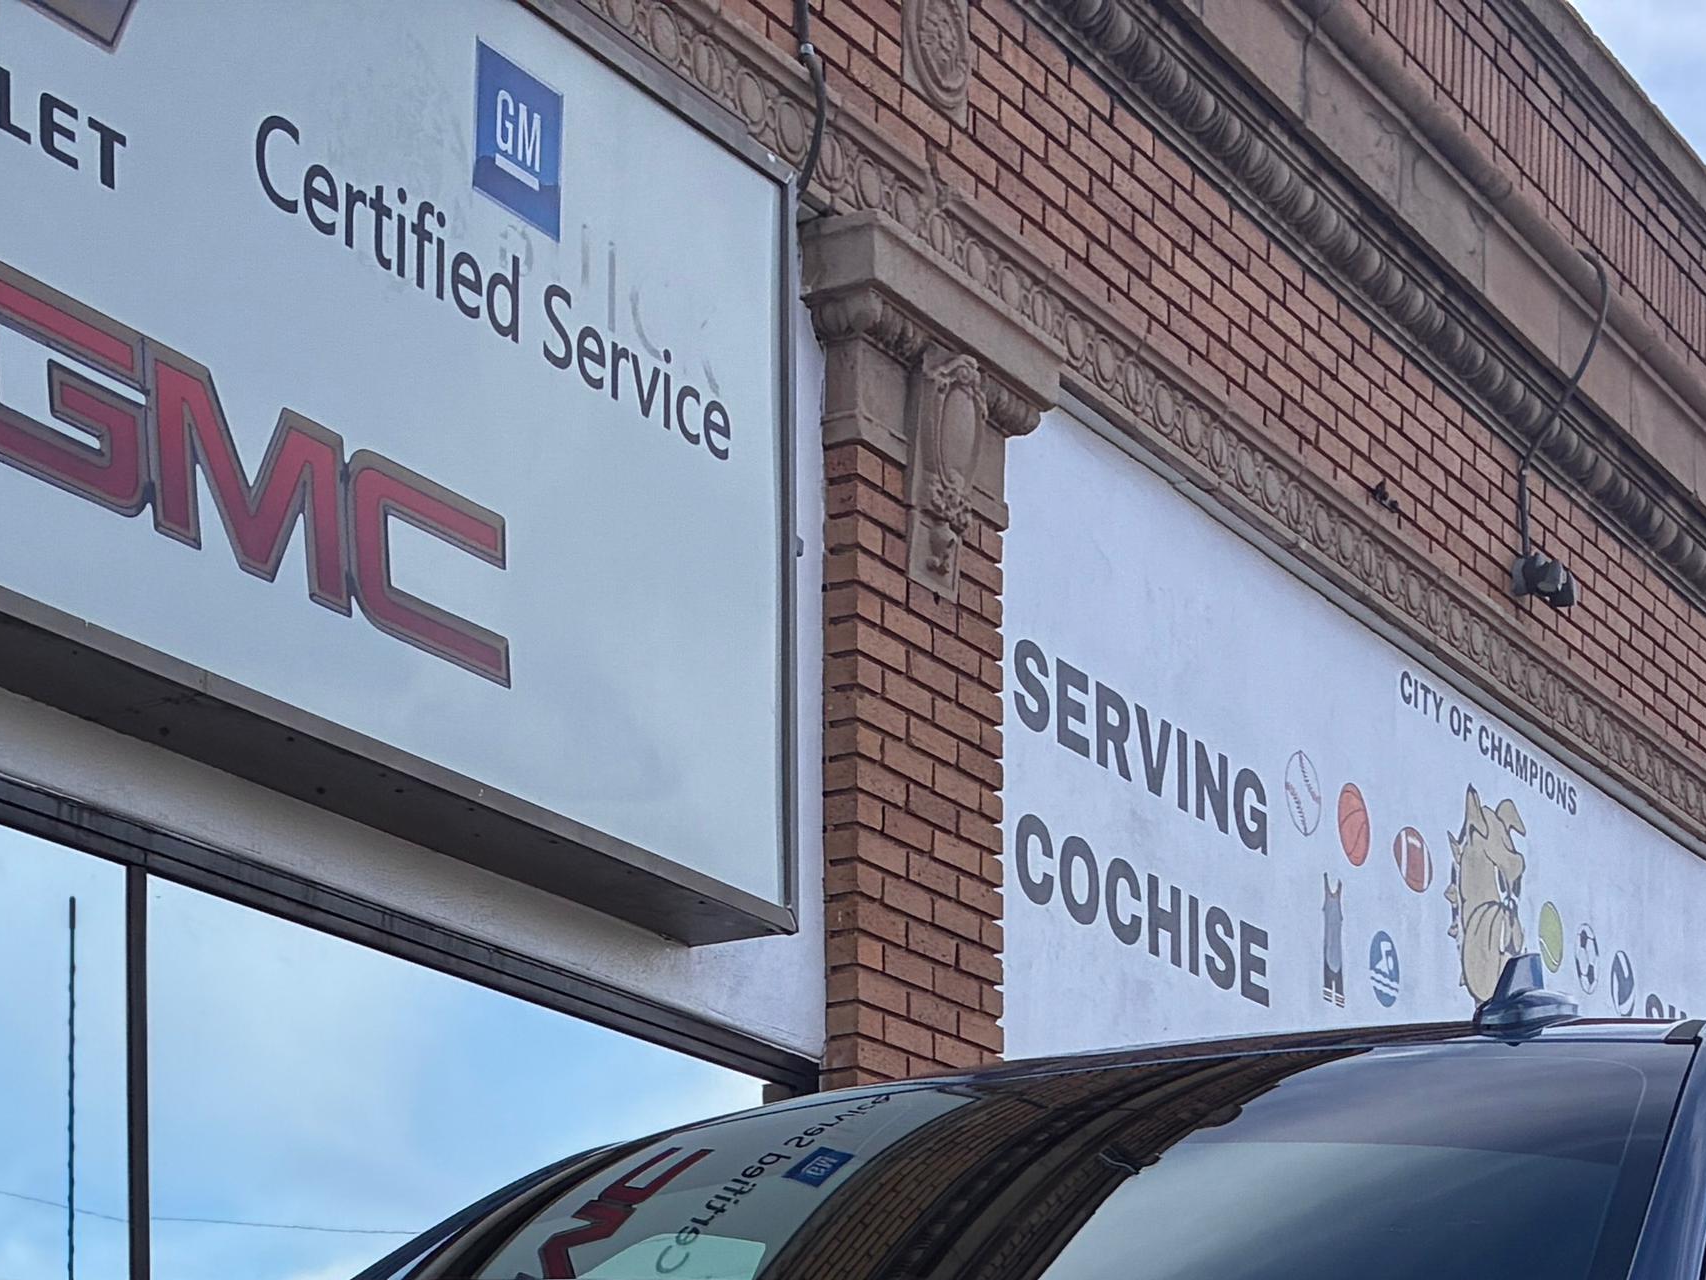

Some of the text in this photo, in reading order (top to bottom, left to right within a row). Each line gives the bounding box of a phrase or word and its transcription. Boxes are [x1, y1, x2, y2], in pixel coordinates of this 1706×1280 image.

[496, 89, 542, 173] GM
[255, 115, 520, 343] Certified
[542, 284, 732, 459] Service
[1013, 637, 1270, 856] SERVING
[1399, 670, 1579, 816] CITY OF CHAMPIONS
[1015, 813, 1271, 1008] COCHISE
